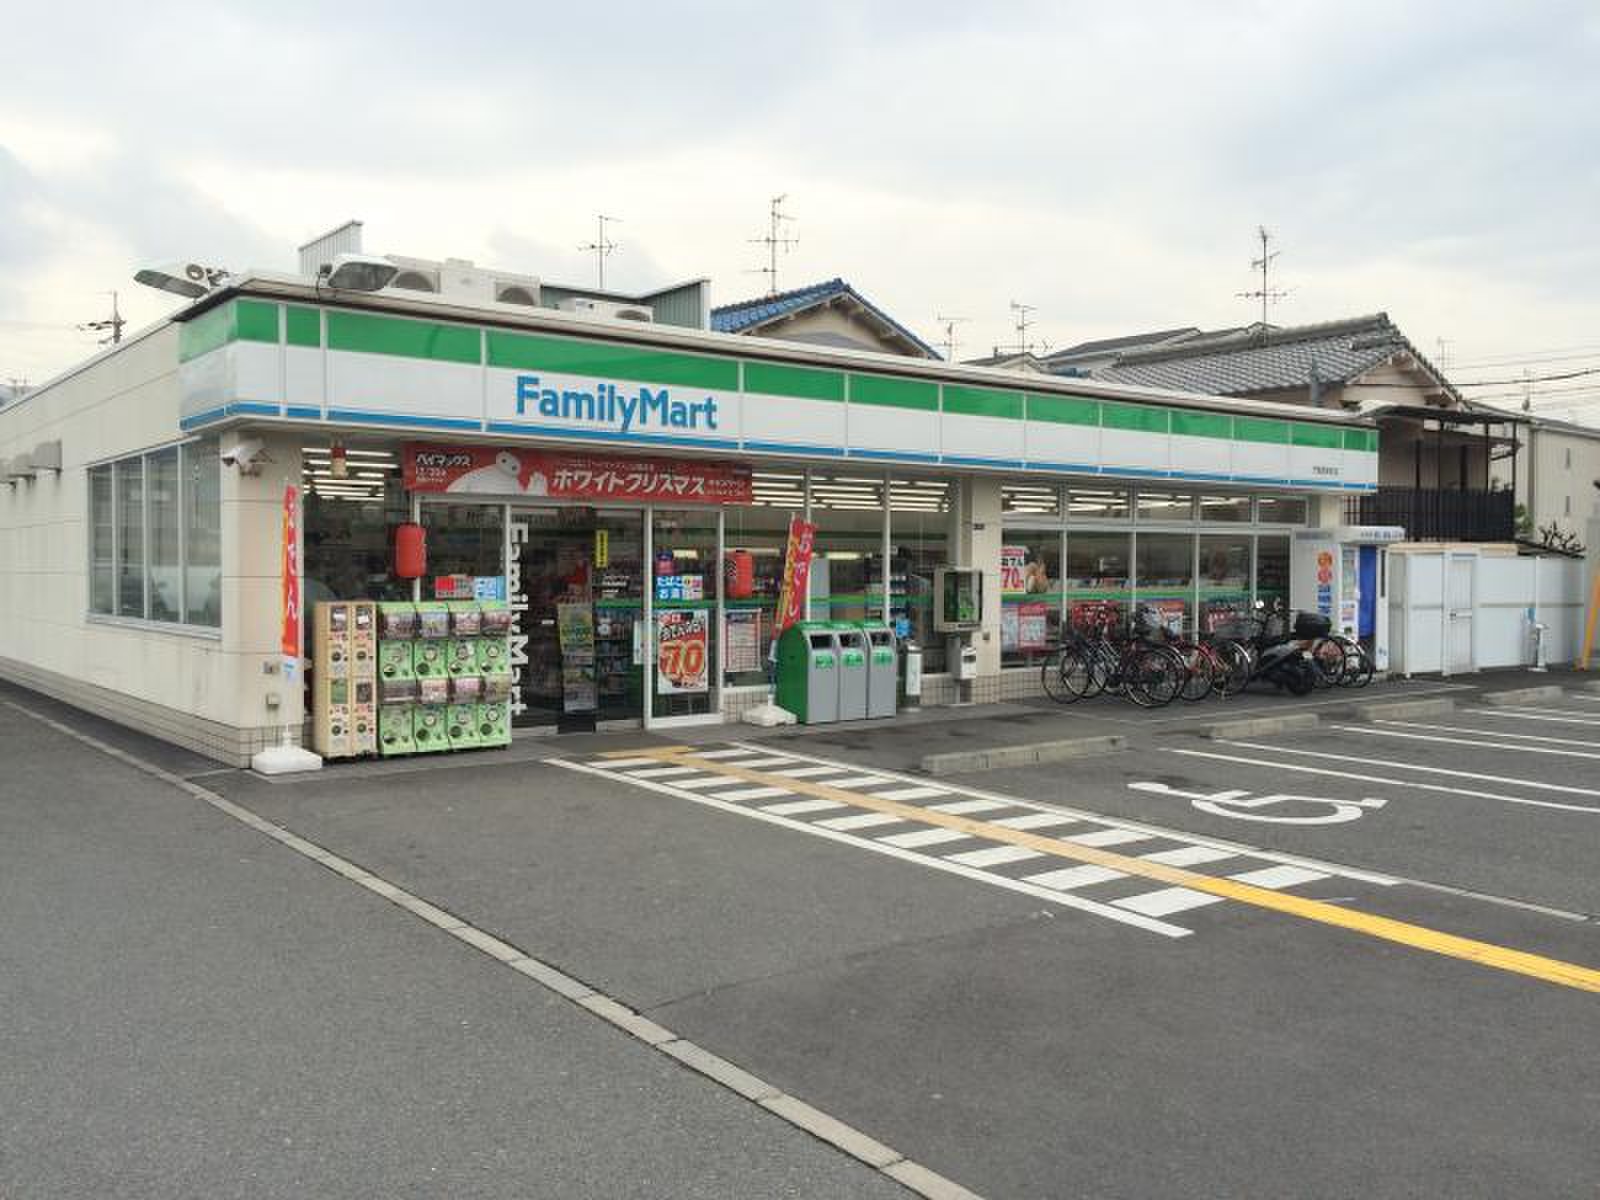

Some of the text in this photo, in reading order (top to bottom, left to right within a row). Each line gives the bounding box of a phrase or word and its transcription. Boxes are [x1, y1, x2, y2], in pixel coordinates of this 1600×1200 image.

[516, 375, 718, 432] FamilyMart
[552, 468, 705, 495] ホワイトクリスマス
[511, 522, 529, 717] FamilyMart
[659, 639, 706, 676] 70
